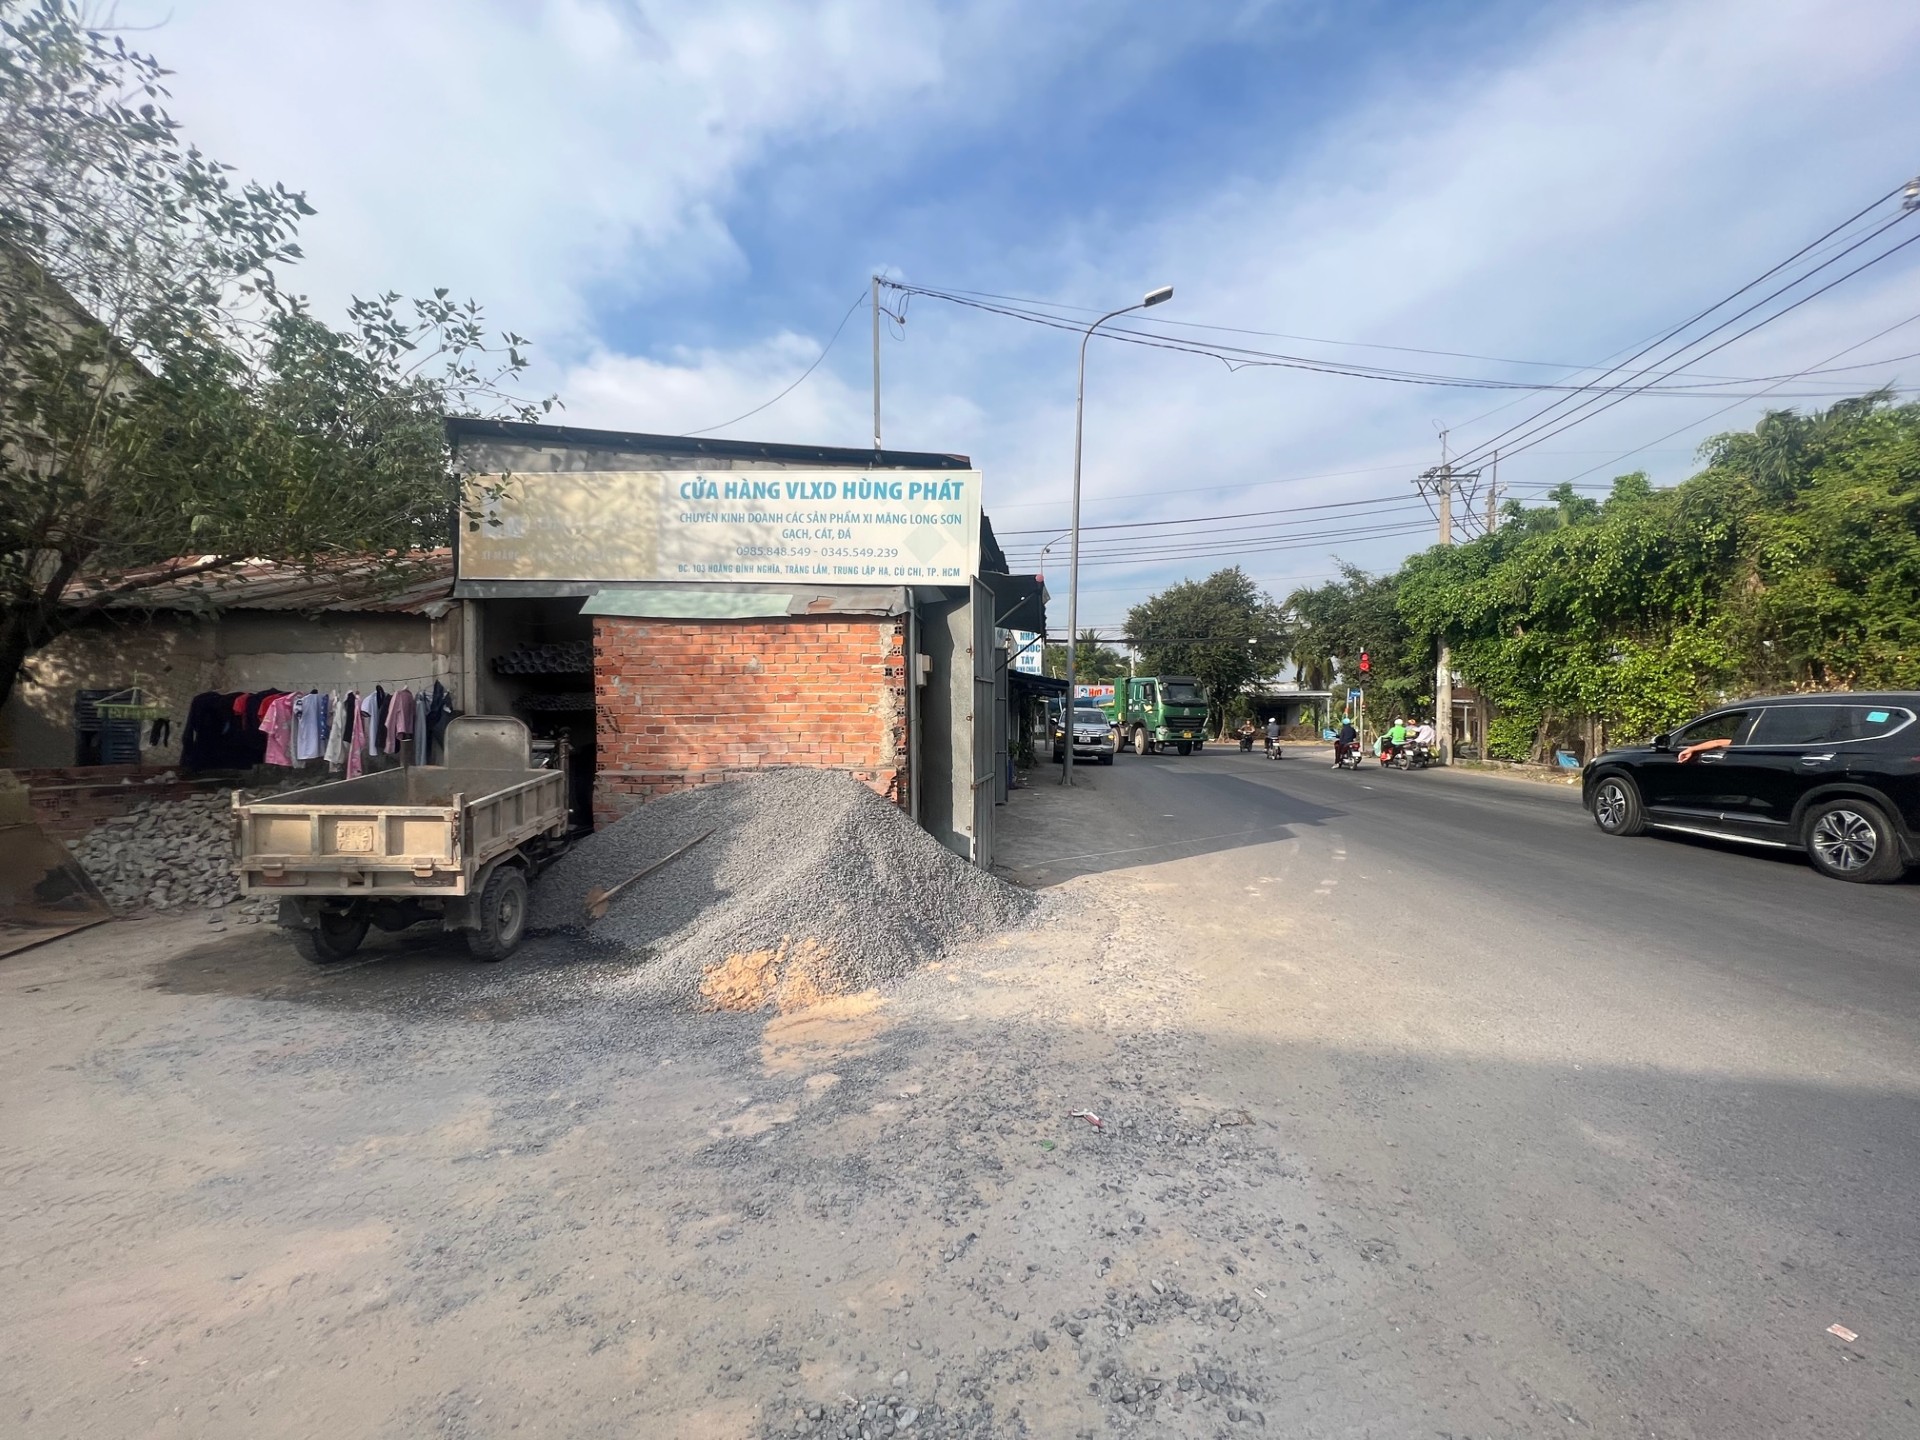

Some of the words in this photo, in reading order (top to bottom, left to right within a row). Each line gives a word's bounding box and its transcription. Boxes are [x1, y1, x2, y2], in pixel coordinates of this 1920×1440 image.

[680, 476, 719, 500] CỬA
[724, 478, 780, 500] HÀNG
[786, 481, 837, 500] VLXD
[842, 478, 903, 500] HÙNG
[908, 478, 964, 501] PHÁT
[680, 511, 719, 523] CHUYÊN
[721, 512, 745, 523] KINH
[748, 512, 783, 524] DOANH
[785, 511, 804, 524] CÁC
[806, 511, 827, 524] SẢN
[829, 510, 860, 524] PHẨM
[863, 513, 872, 524] XI
[875, 512, 907, 524] MĂNG
[910, 514, 938, 525] LONG
[940, 514, 962, 525] SƠN
[782, 528, 812, 541] GẠCH,
[815, 528, 835, 540] CÁT,
[837, 527, 851, 540] ĐÁ
[736, 546, 811, 557] 0985.848.549
[821, 547, 899, 558] 0345.549.239
[693, 564, 706, 573] 103
[832, 565, 858, 575] TRUNG
[907, 567, 924, 578] CHI,
[927, 568, 939, 577] TP.
[942, 568, 960, 577] HCM
